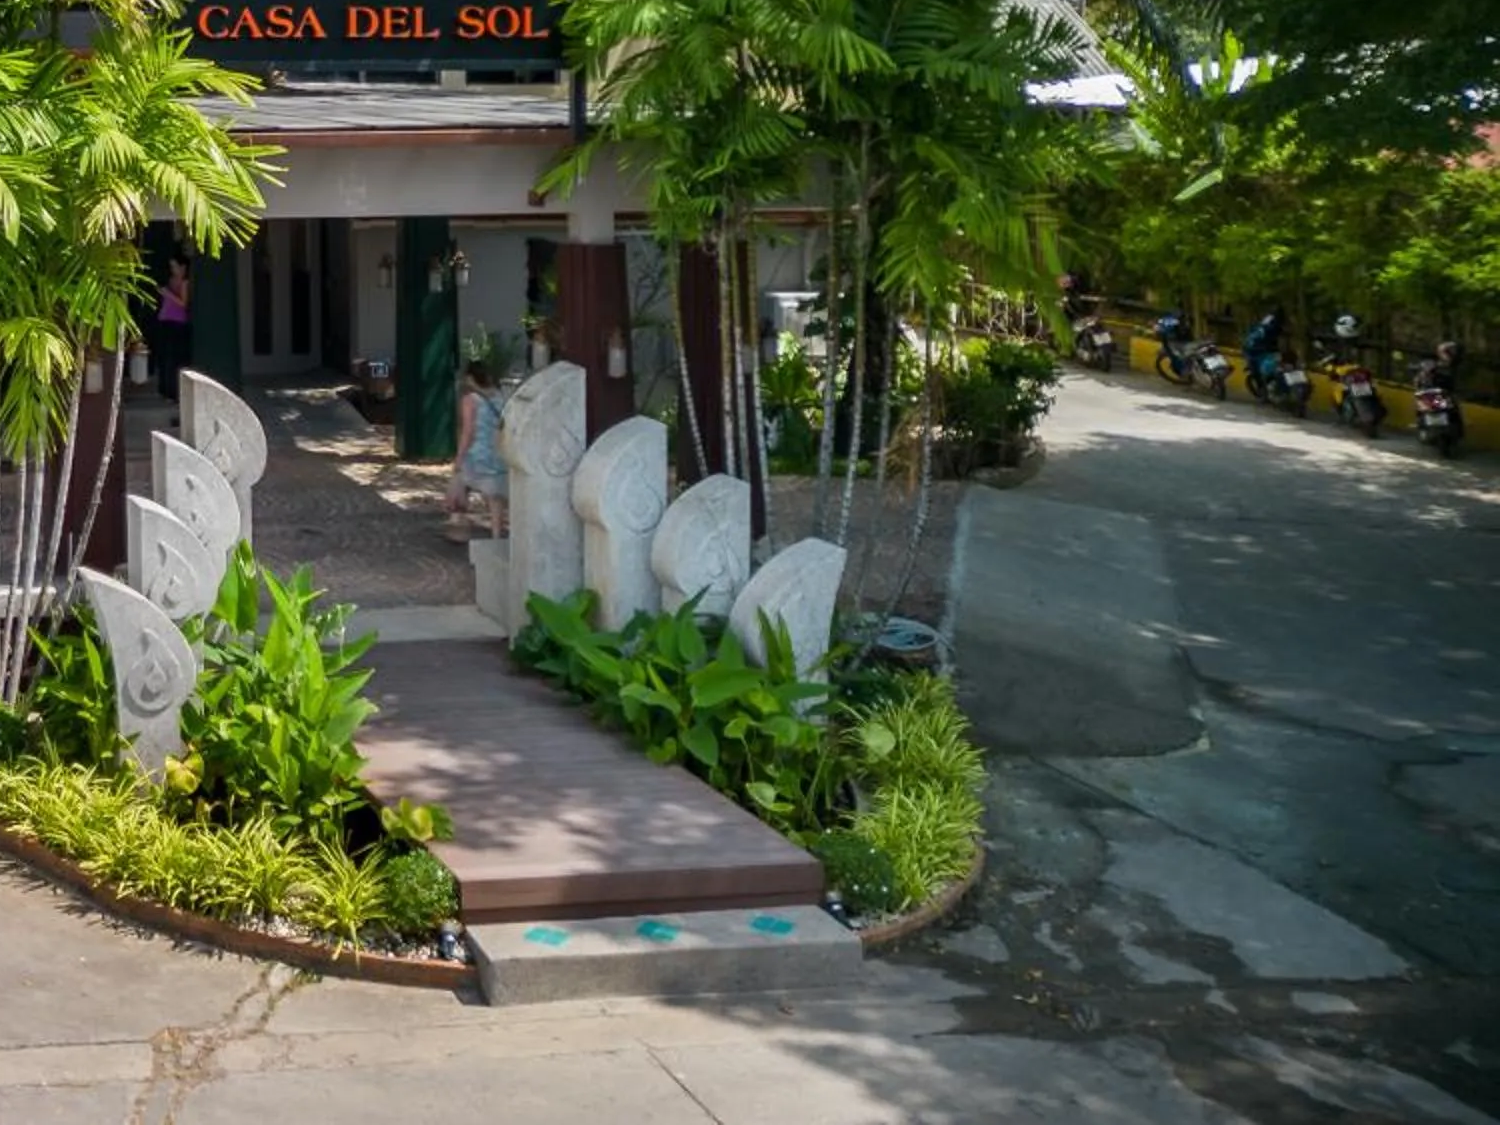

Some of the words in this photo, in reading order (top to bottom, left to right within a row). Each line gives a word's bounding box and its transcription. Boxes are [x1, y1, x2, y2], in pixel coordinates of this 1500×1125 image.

[197, 4, 328, 40] CASA
[346, 4, 441, 40] DEL
[456, 4, 550, 40] SOL
